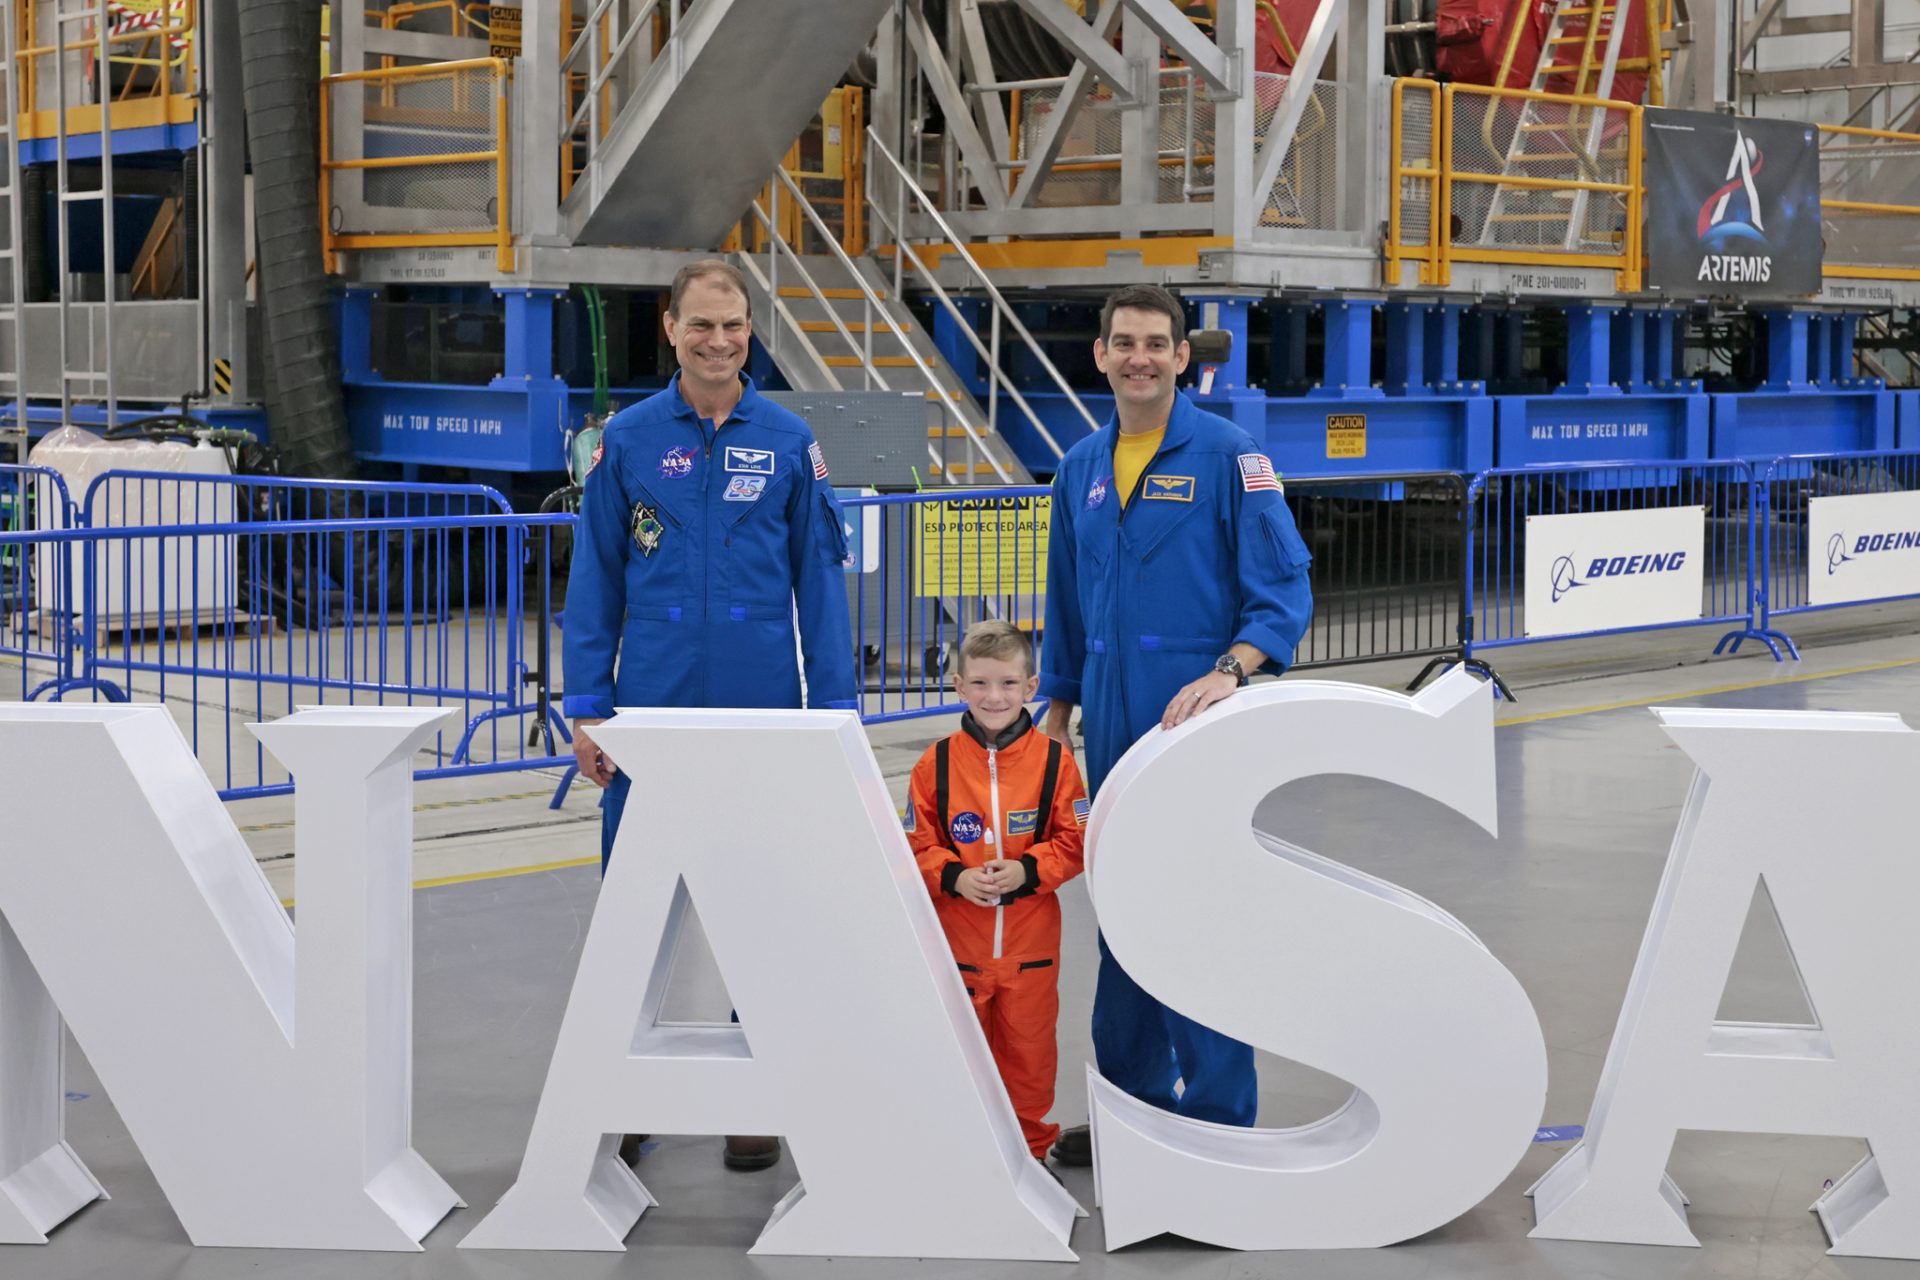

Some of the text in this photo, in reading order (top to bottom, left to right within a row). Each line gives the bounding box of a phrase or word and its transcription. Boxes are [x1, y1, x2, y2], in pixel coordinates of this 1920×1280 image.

[1698, 255, 1771, 282] ARTEMIS
[384, 414, 403, 429] MAX
[410, 415, 430, 430] TOW
[437, 416, 468, 432] SPEED
[1330, 417, 1364, 428] CAUTION
[1532, 426, 1553, 439] MAX
[1560, 424, 1580, 438] TOW
[1586, 424, 1618, 438] SPEED
[662, 458, 692, 467] NASA
[949, 497, 1027, 507] CAUTON
[925, 522, 946, 532] ESD
[1018, 521, 1048, 532] AREA
[1585, 551, 1686, 578] BOEING
[953, 823, 981, 832] NASA
